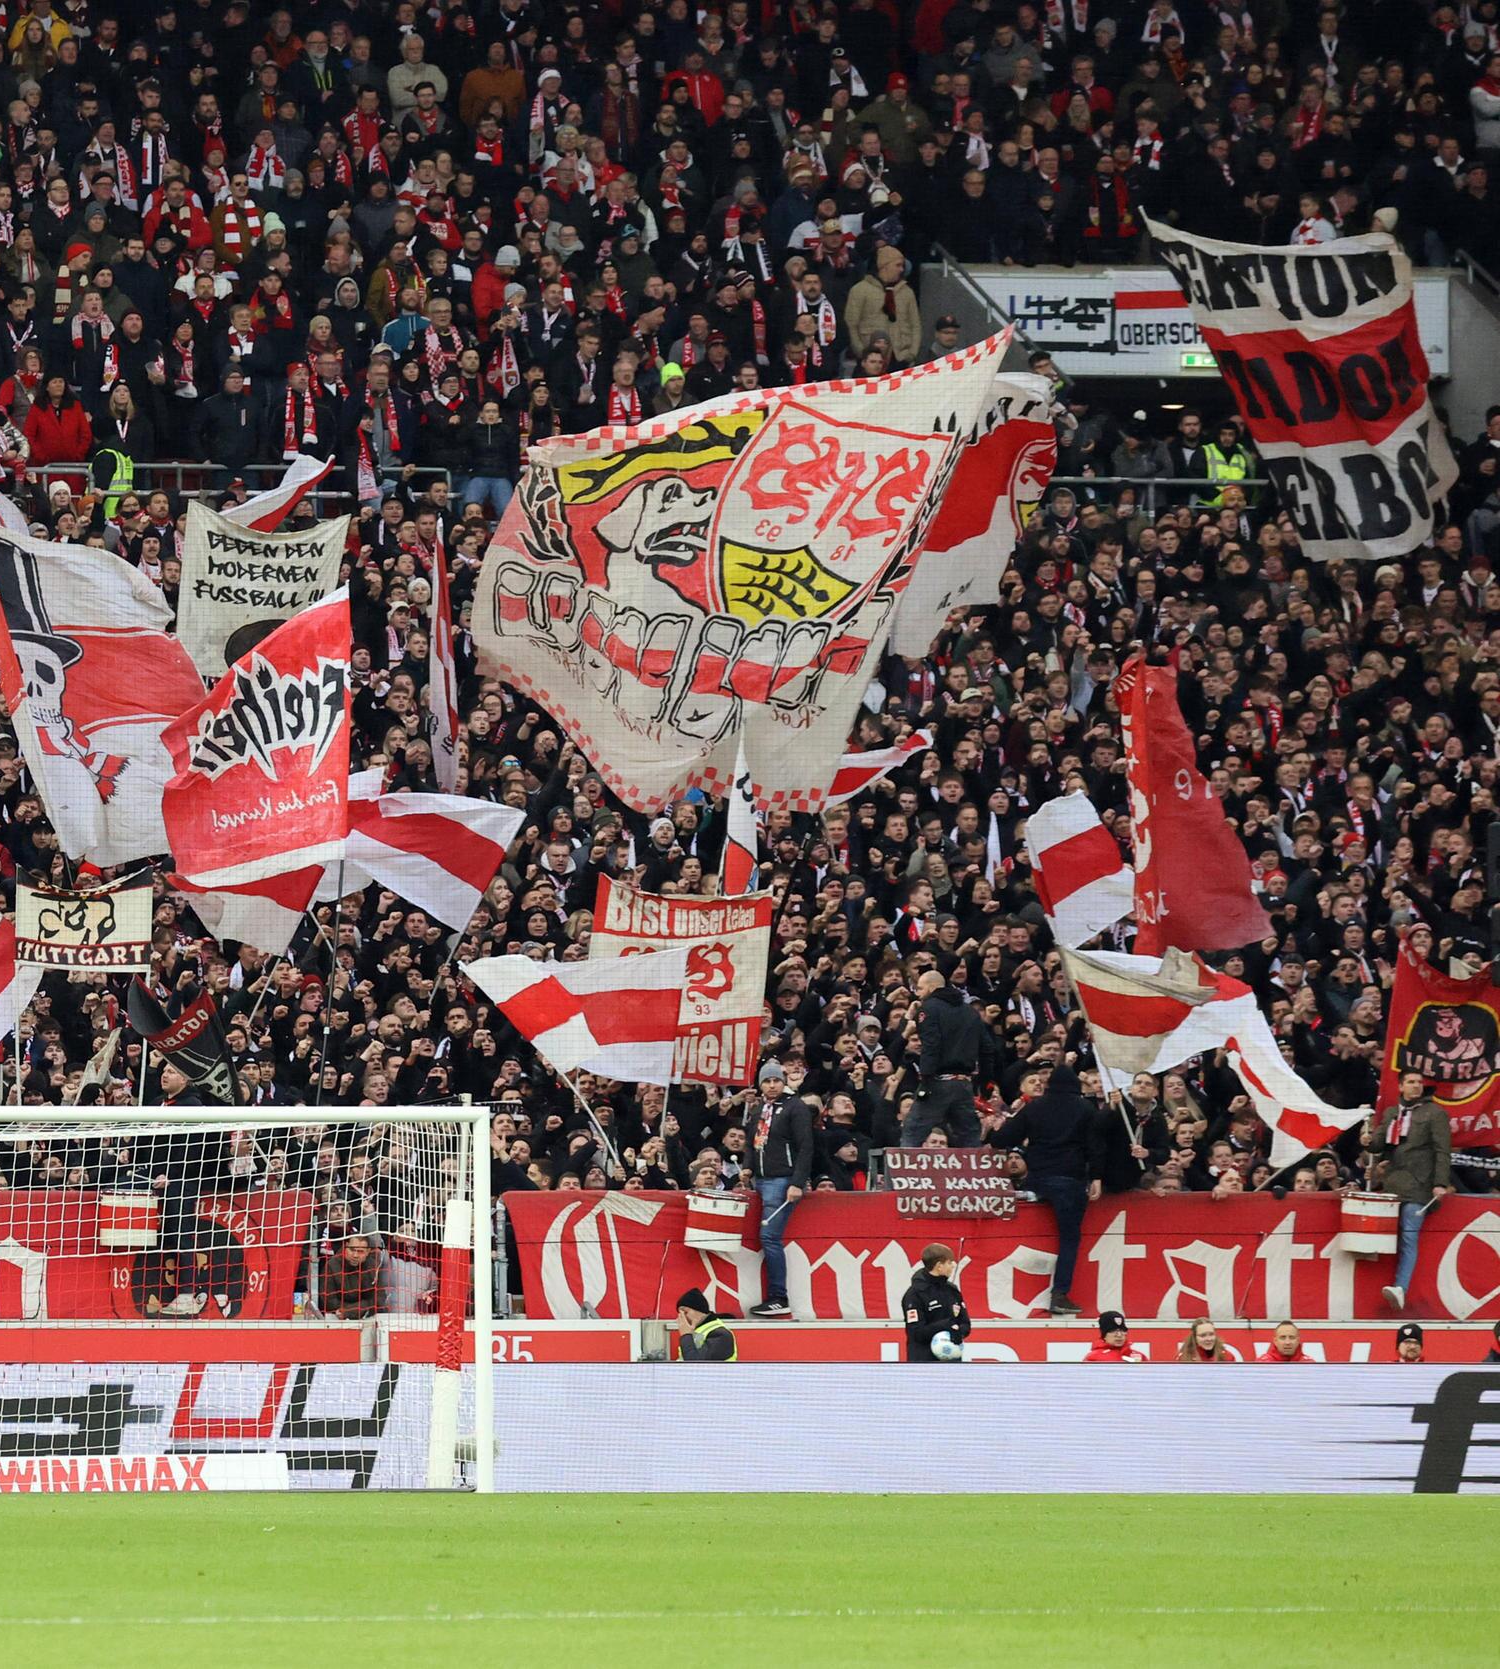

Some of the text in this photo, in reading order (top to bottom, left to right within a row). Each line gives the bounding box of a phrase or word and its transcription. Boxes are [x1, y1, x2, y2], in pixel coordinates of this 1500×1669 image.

[207, 530, 325, 559] GEGEN DEN
[208, 555, 319, 584] MODERNEN
[193, 579, 303, 609] FUSSBALL
[674, 907, 725, 938] unser
[694, 1004, 711, 1016] 93
[970, 1154, 1007, 1170] IST
[891, 1176, 1012, 1190] DER KAMPF
[896, 1195, 1017, 1216] UMS GANZE
[112, 1266, 269, 1293] 19 97
